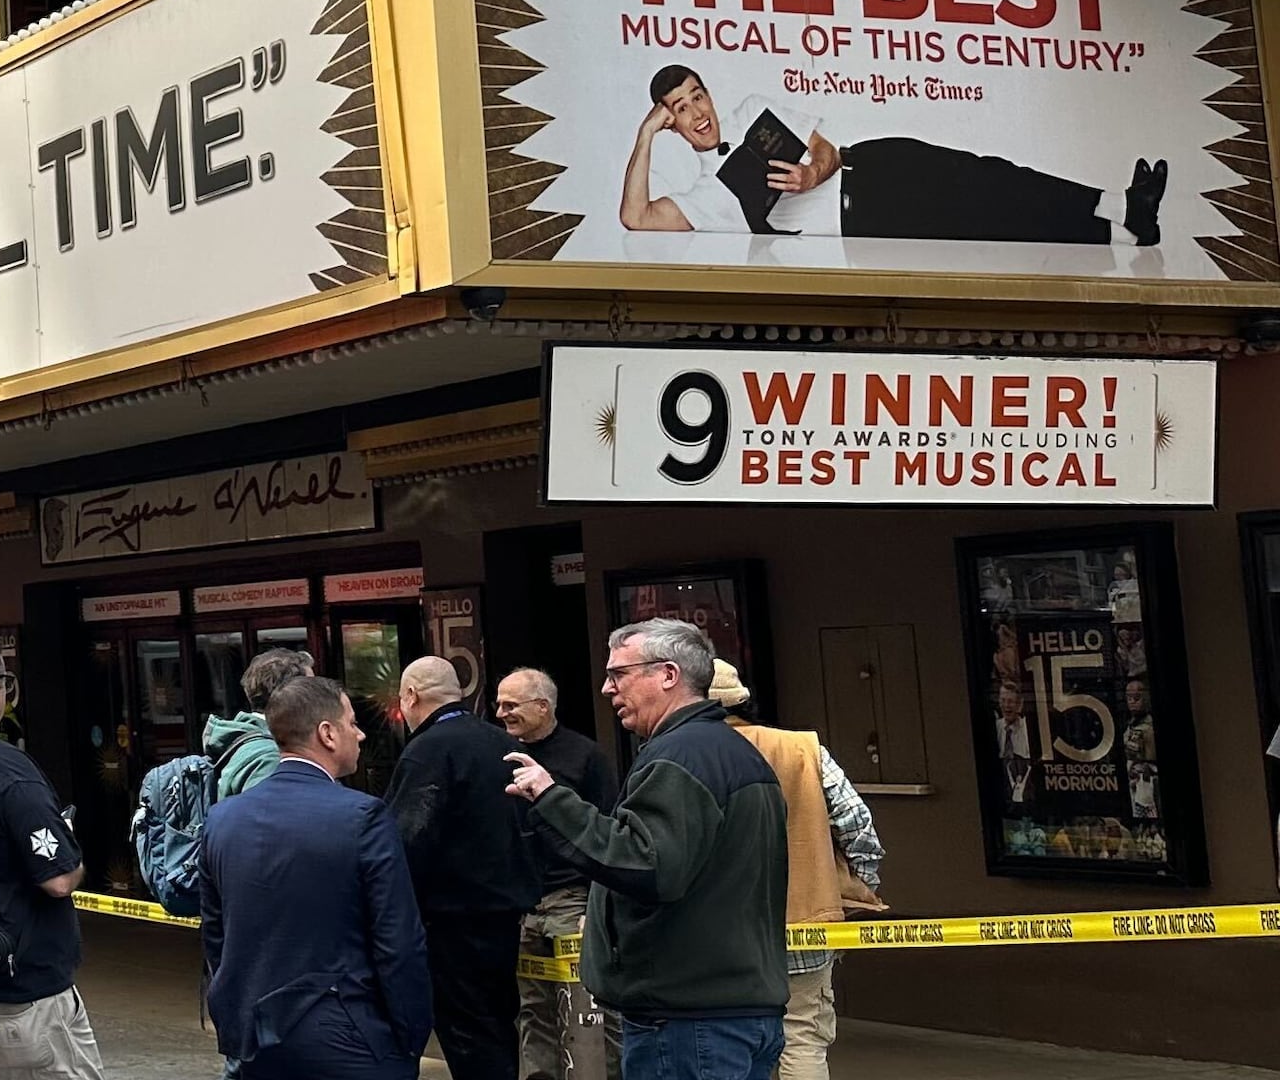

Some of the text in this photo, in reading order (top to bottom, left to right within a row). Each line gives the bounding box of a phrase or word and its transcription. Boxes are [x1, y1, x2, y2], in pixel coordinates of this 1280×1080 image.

[621, 14, 1144, 72] MUSICAL OF THIS CENTURY.”
[784, 68, 983, 104] The New York Times
[38, 39, 287, 253] TIME.”
[743, 371, 1118, 428] WINNER!
[657, 369, 732, 486] 9
[743, 429, 815, 446] TONY
[970, 432, 1118, 448] INCLUDING
[741, 450, 1118, 487] BEST MUSICAL
[75, 488, 196, 551] Eugene
[430, 598, 474, 616] HELLO
[1029, 629, 1104, 653] HELLO
[1024, 653, 1115, 762] 15
[1043, 763, 1116, 774] THE BOOK OF
[1044, 776, 1118, 792] MORMON
[860, 926, 875, 944] FIRE
[893, 925, 904, 943] DO
[905, 924, 919, 942] NOT
[920, 924, 944, 942] CROSS
[980, 922, 997, 940] FIRE
[1017, 920, 1029, 938] DO
[1030, 920, 1045, 938] NOT
[1047, 919, 1072, 938] CROSS
[1113, 916, 1132, 936] FIRE
[1155, 915, 1167, 934] DO
[1168, 914, 1186, 934] NOT
[1187, 912, 1216, 933] CROSS
[792, 928, 804, 946] NOT
[806, 927, 827, 946] CROSS
